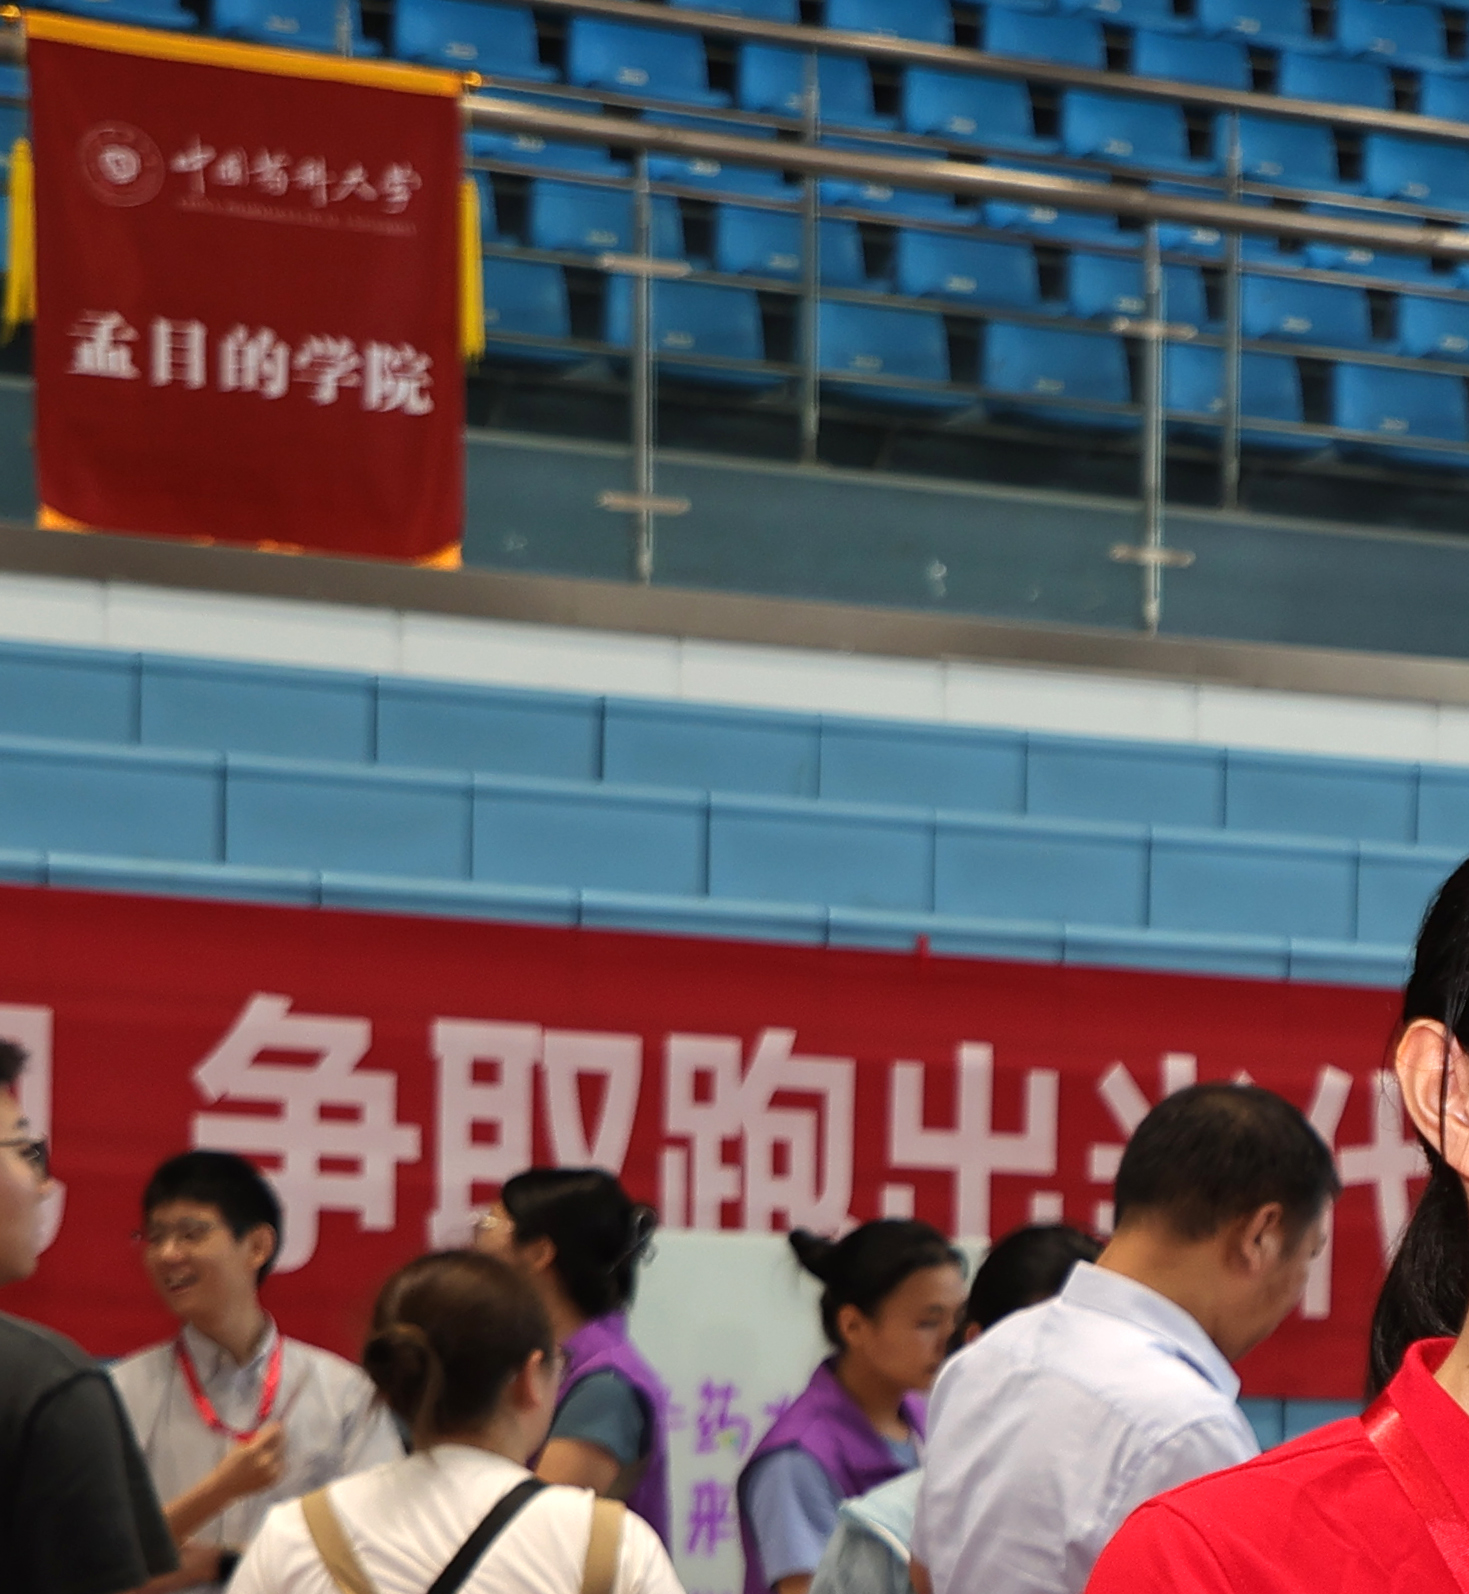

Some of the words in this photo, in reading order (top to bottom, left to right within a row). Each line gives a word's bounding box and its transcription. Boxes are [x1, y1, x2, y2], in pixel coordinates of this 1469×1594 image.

[67, 309, 436, 417] 孟目的学院
